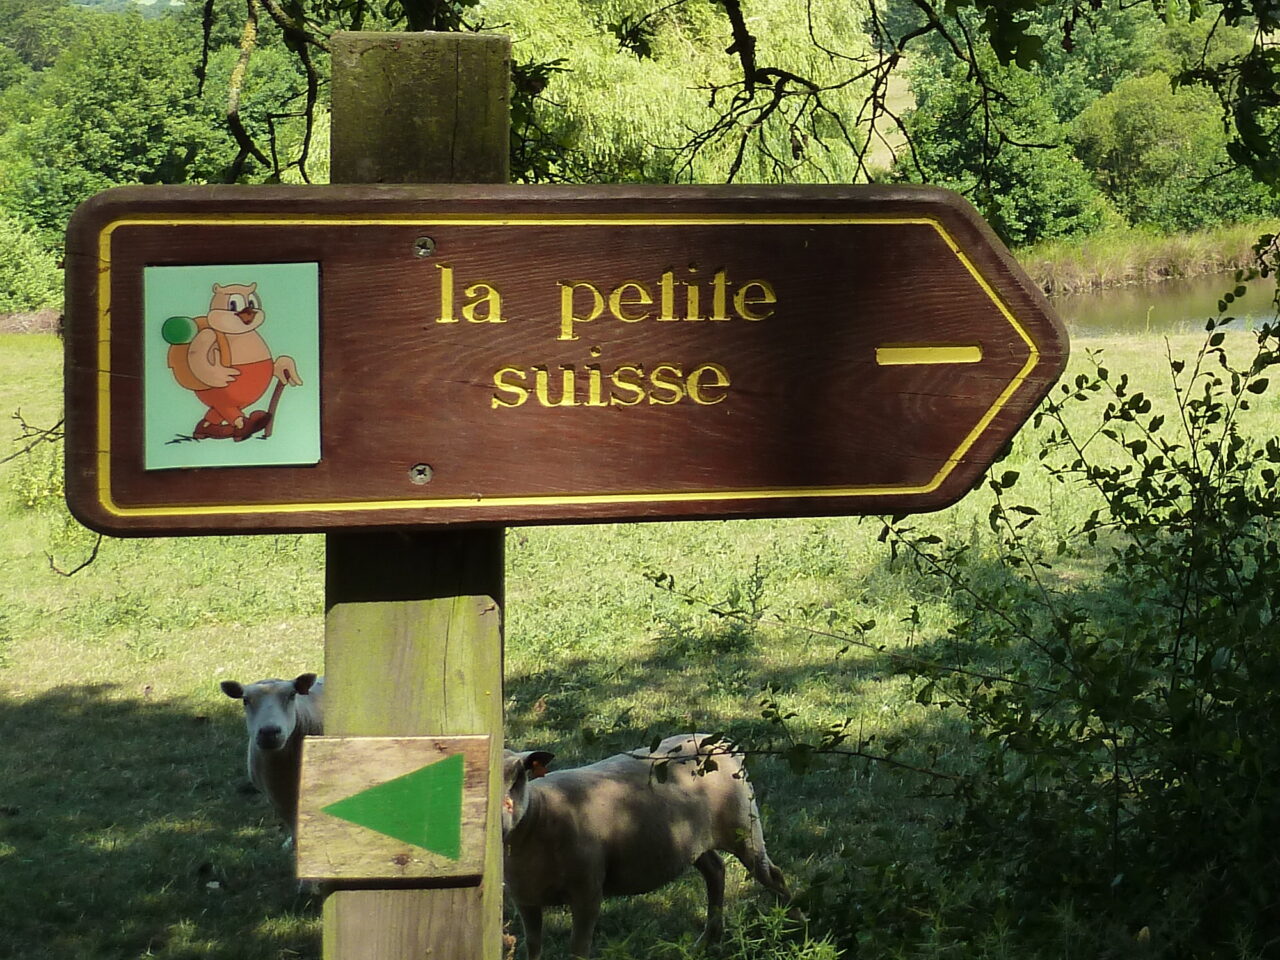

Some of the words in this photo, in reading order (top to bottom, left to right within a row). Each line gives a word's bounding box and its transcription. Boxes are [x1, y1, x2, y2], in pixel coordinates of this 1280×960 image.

[435, 263, 508, 324] la
[556, 262, 777, 341] petite
[490, 346, 731, 410] suisse
